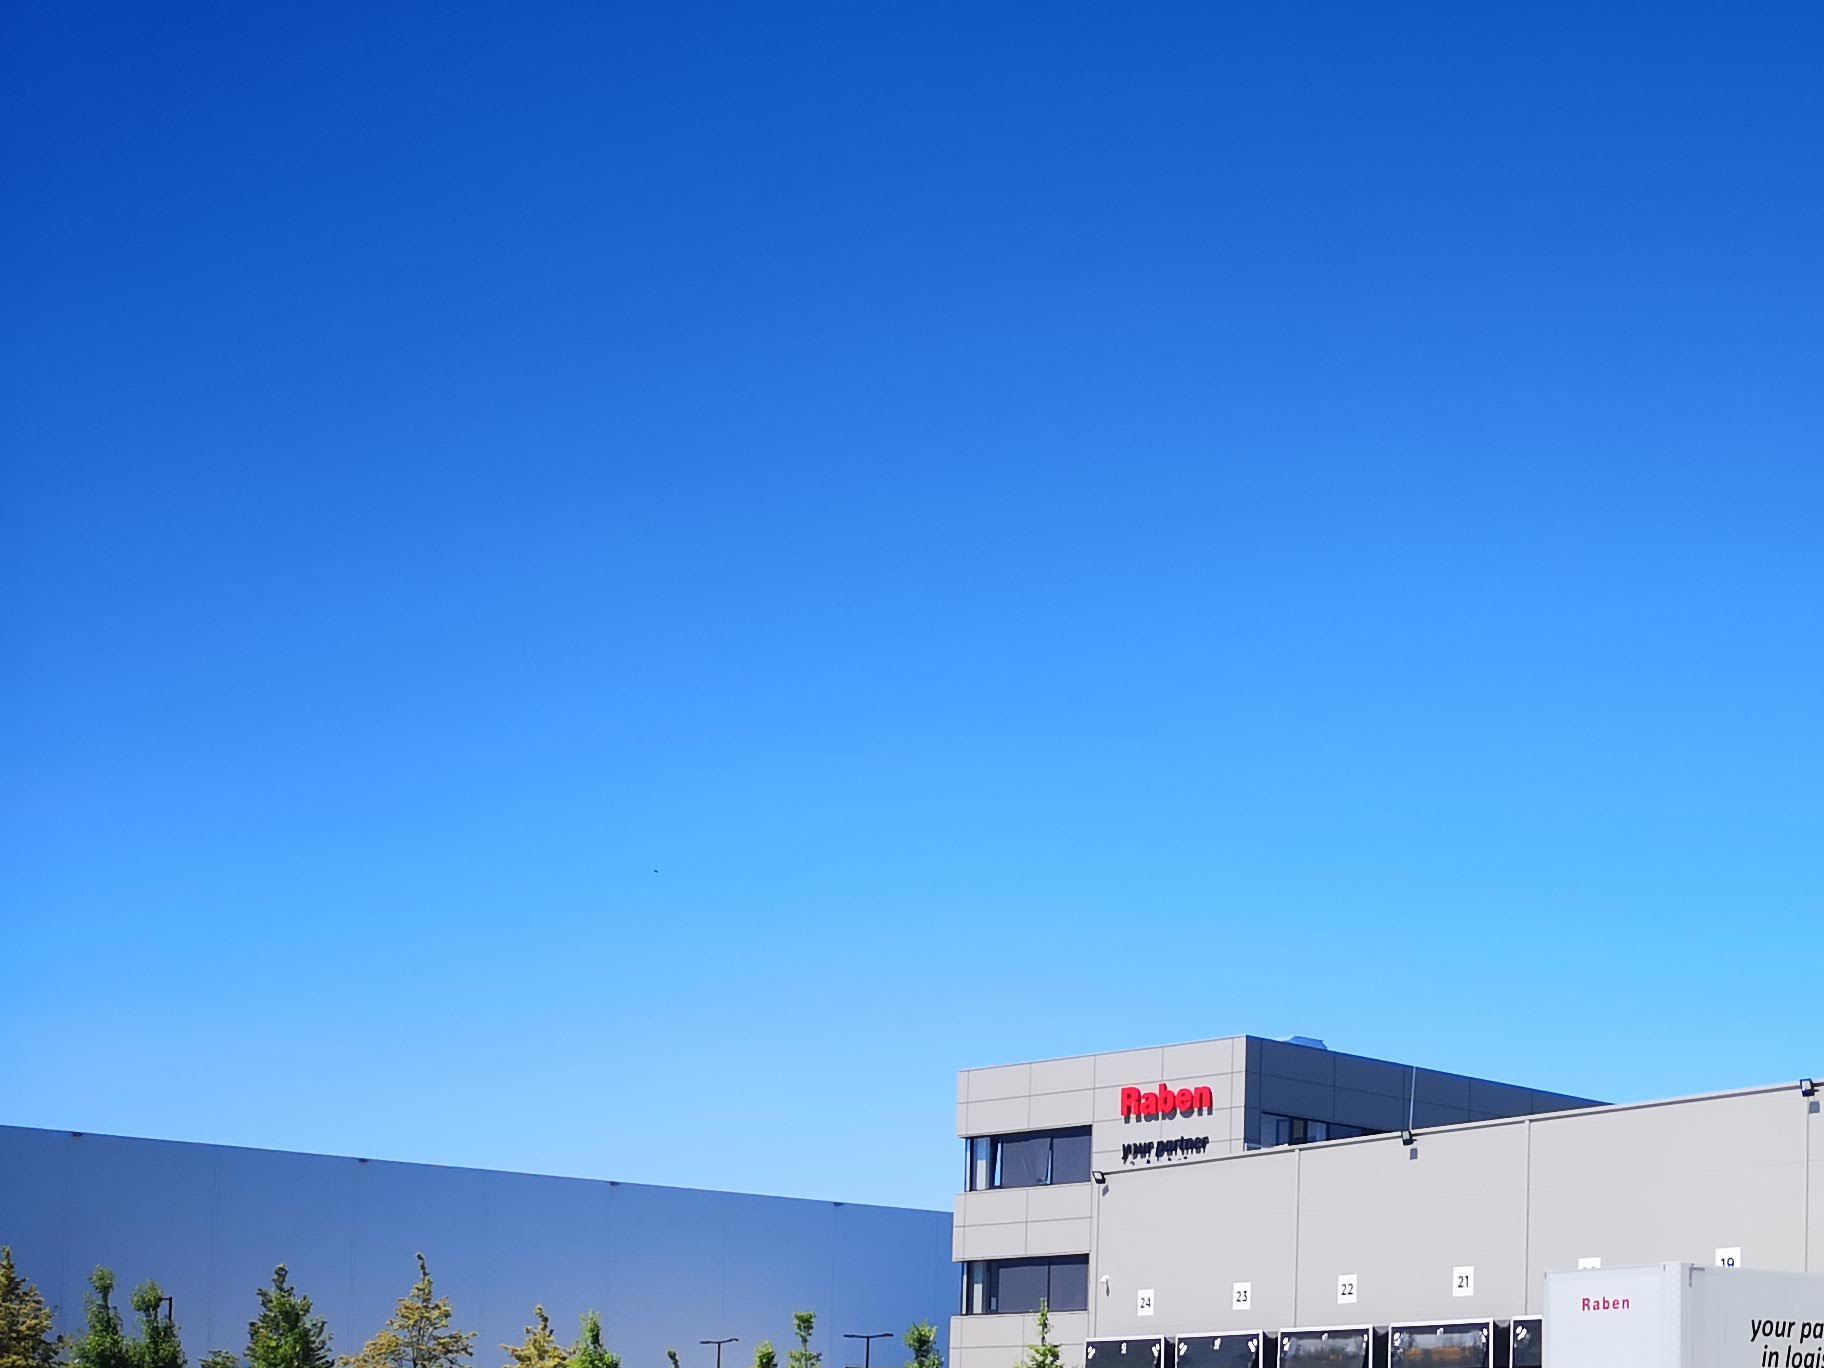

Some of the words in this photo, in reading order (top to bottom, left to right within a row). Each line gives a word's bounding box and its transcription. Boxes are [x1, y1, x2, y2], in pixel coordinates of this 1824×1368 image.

[1121, 1083, 1213, 1117] Raben
[1155, 1136, 1209, 1158] partner
[1341, 1283, 1354, 1296] 22
[1457, 1275, 1469, 1288] 21
[1140, 1297, 1151, 1309] 24
[1236, 1290, 1248, 1303] 23
[1581, 1296, 1631, 1312] Raben
[1750, 1319, 1796, 1342] your
[1761, 1344, 1780, 1368] in
